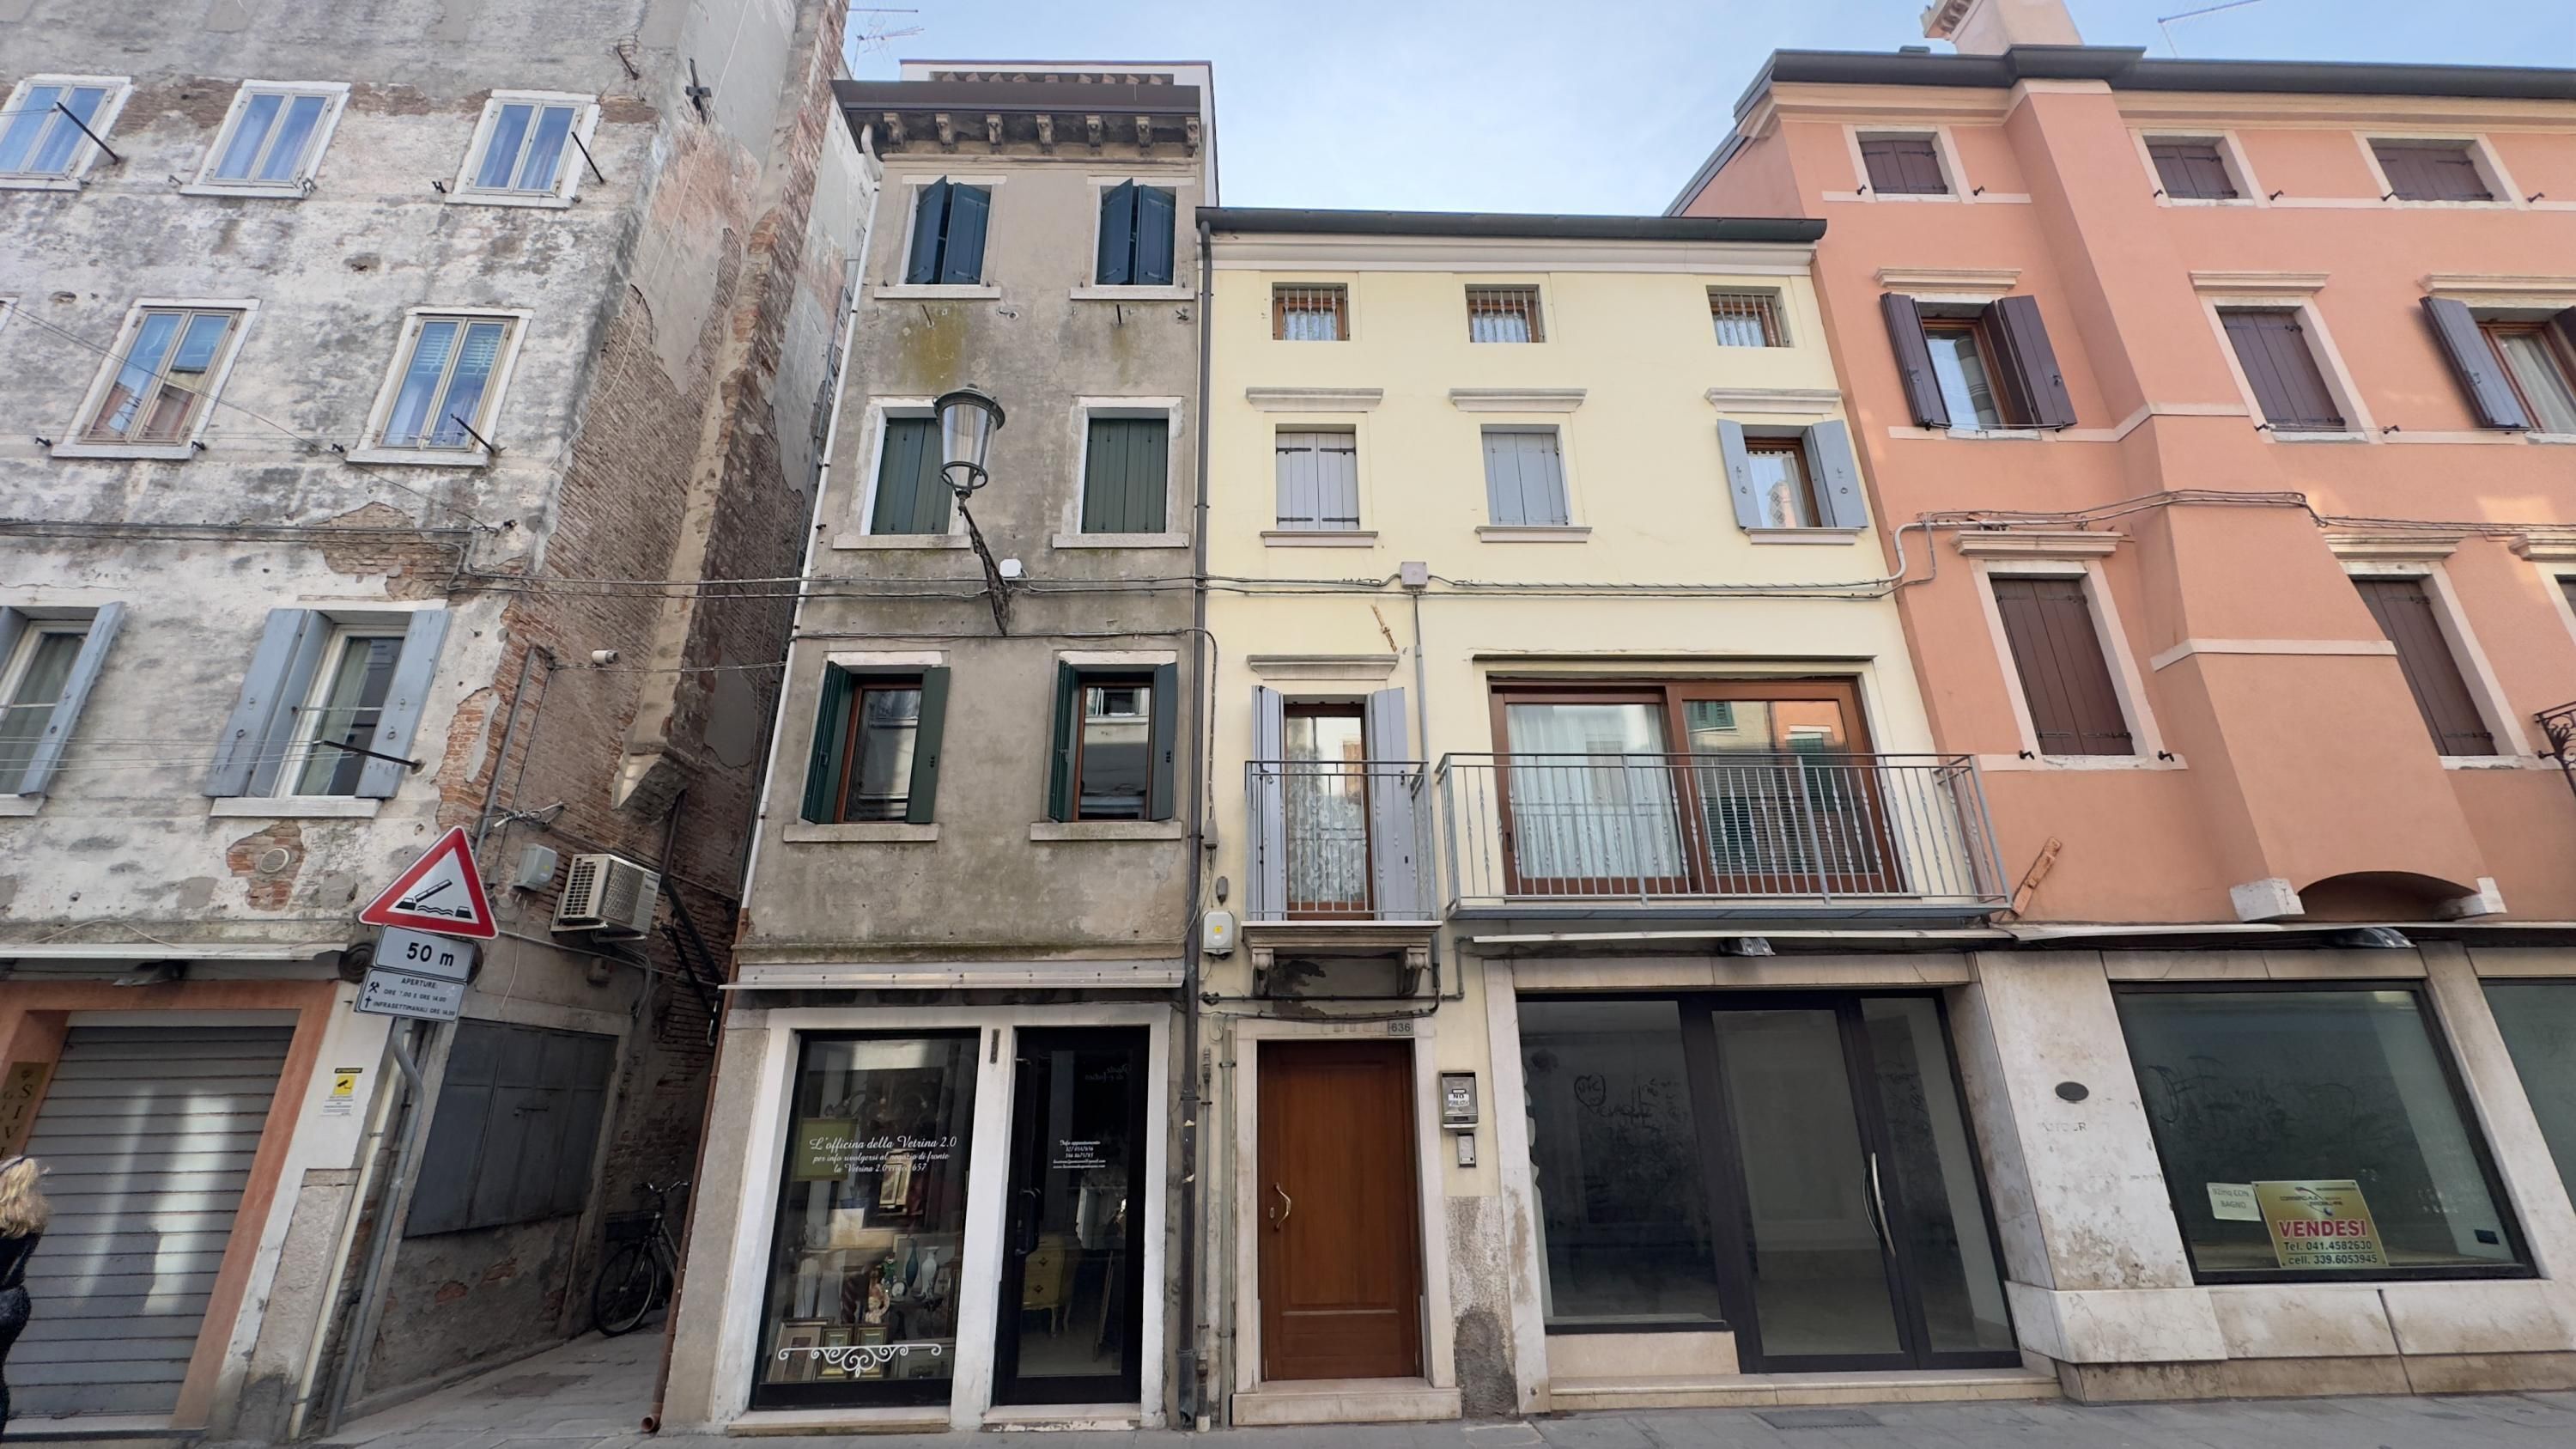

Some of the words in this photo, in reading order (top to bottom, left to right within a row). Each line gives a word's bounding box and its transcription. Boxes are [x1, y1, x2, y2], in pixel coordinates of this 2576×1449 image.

[406, 941, 433, 962] 50
[440, 952, 455, 967] m
[1391, 1022, 1411, 1032] 636
[809, 1136, 865, 1154] L'officina
[866, 1135, 894, 1149] della
[896, 1135, 939, 1148] Vetrina
[939, 1135, 957, 1148] 2.0
[918, 1151, 926, 1160] di
[927, 1151, 950, 1163] fronte
[845, 1163, 874, 1173] Vetrina
[912, 1163, 927, 1172] 657
[2278, 1220, 2366, 1238] VENDESI
[2284, 1241, 2303, 1251] Tel.
[2306, 1240, 2372, 1251] 041.4582630
[2288, 1256, 2312, 1264] cell.
[2313, 1254, 2377, 1264] 339.6053945
